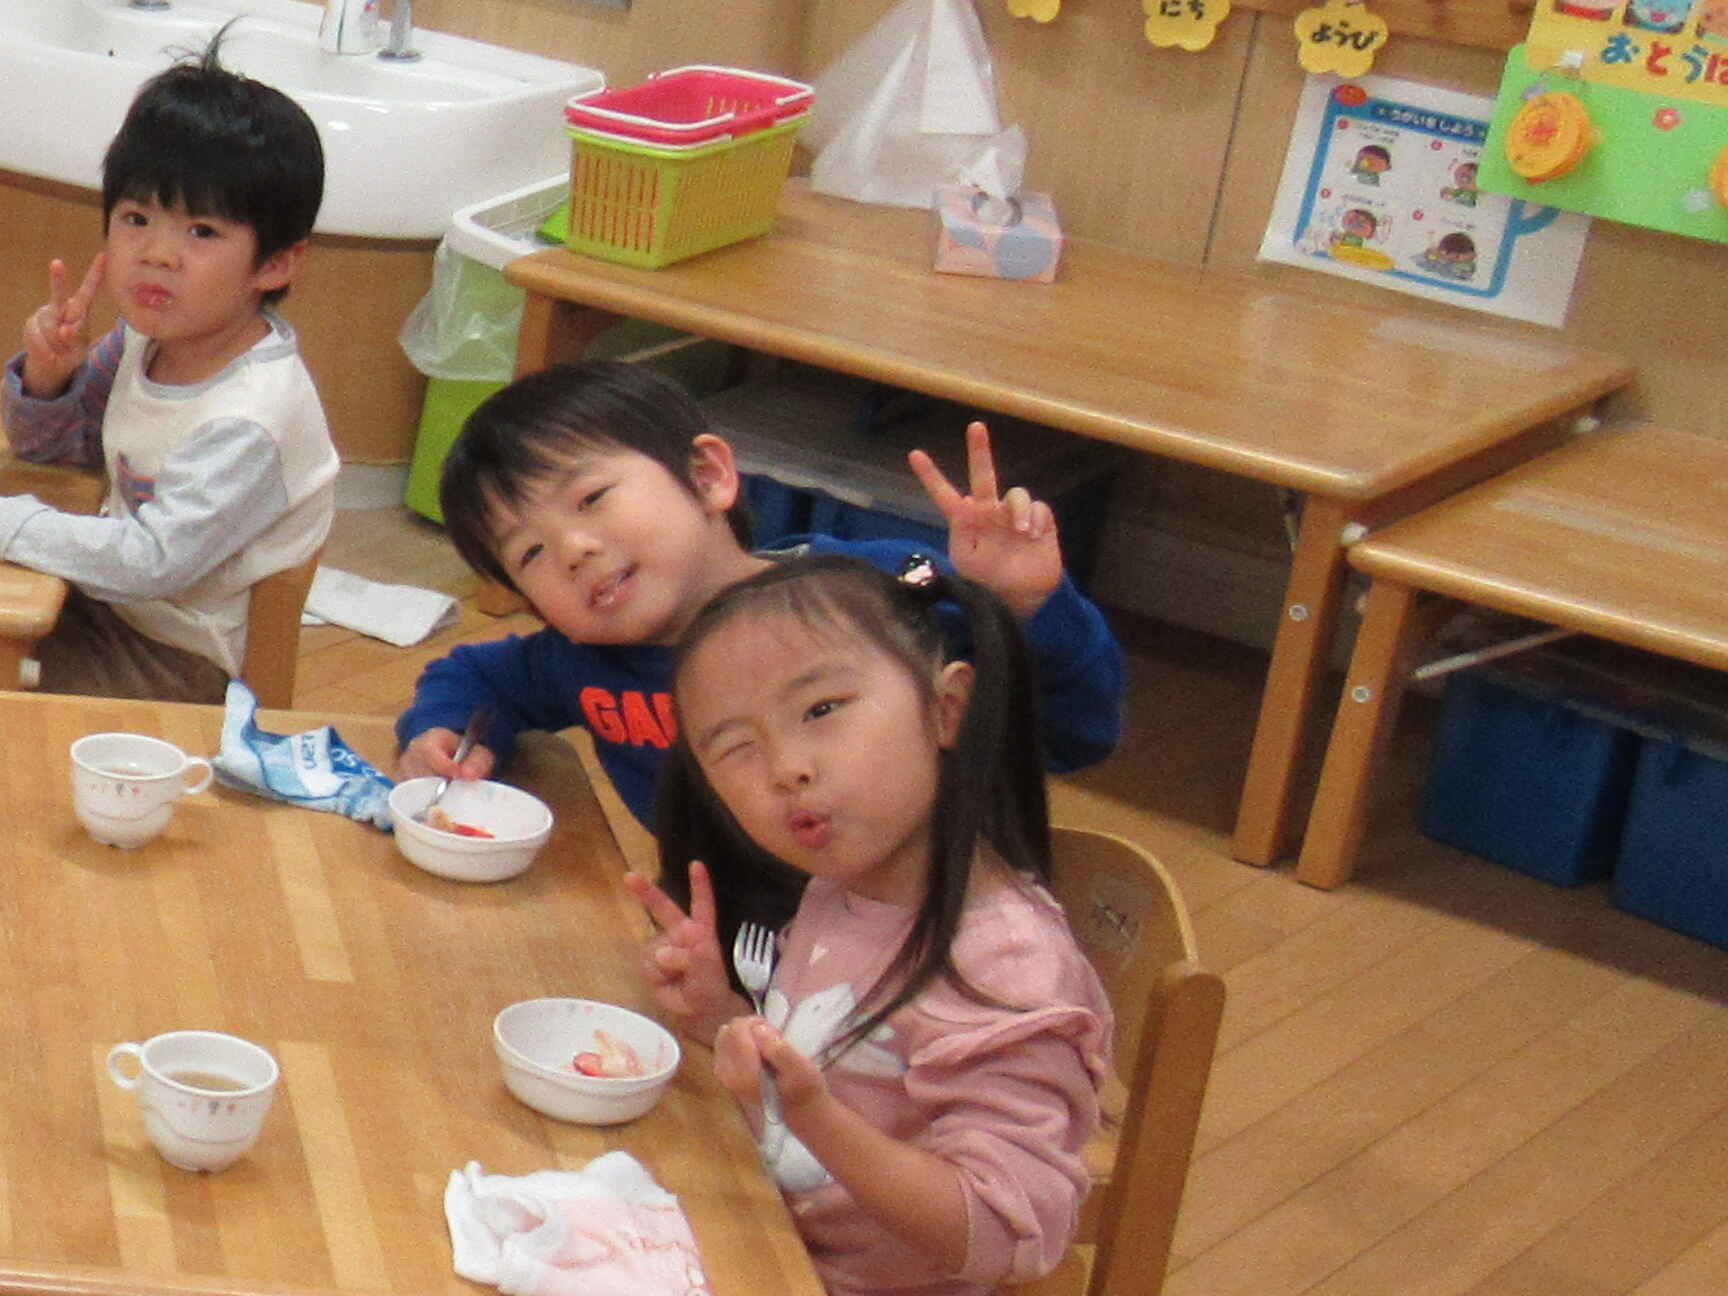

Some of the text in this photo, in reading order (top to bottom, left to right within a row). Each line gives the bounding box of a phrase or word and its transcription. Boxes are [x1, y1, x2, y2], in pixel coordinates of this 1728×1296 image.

[1159, 0, 1206, 20] にち
[1312, 20, 1378, 51] ようび
